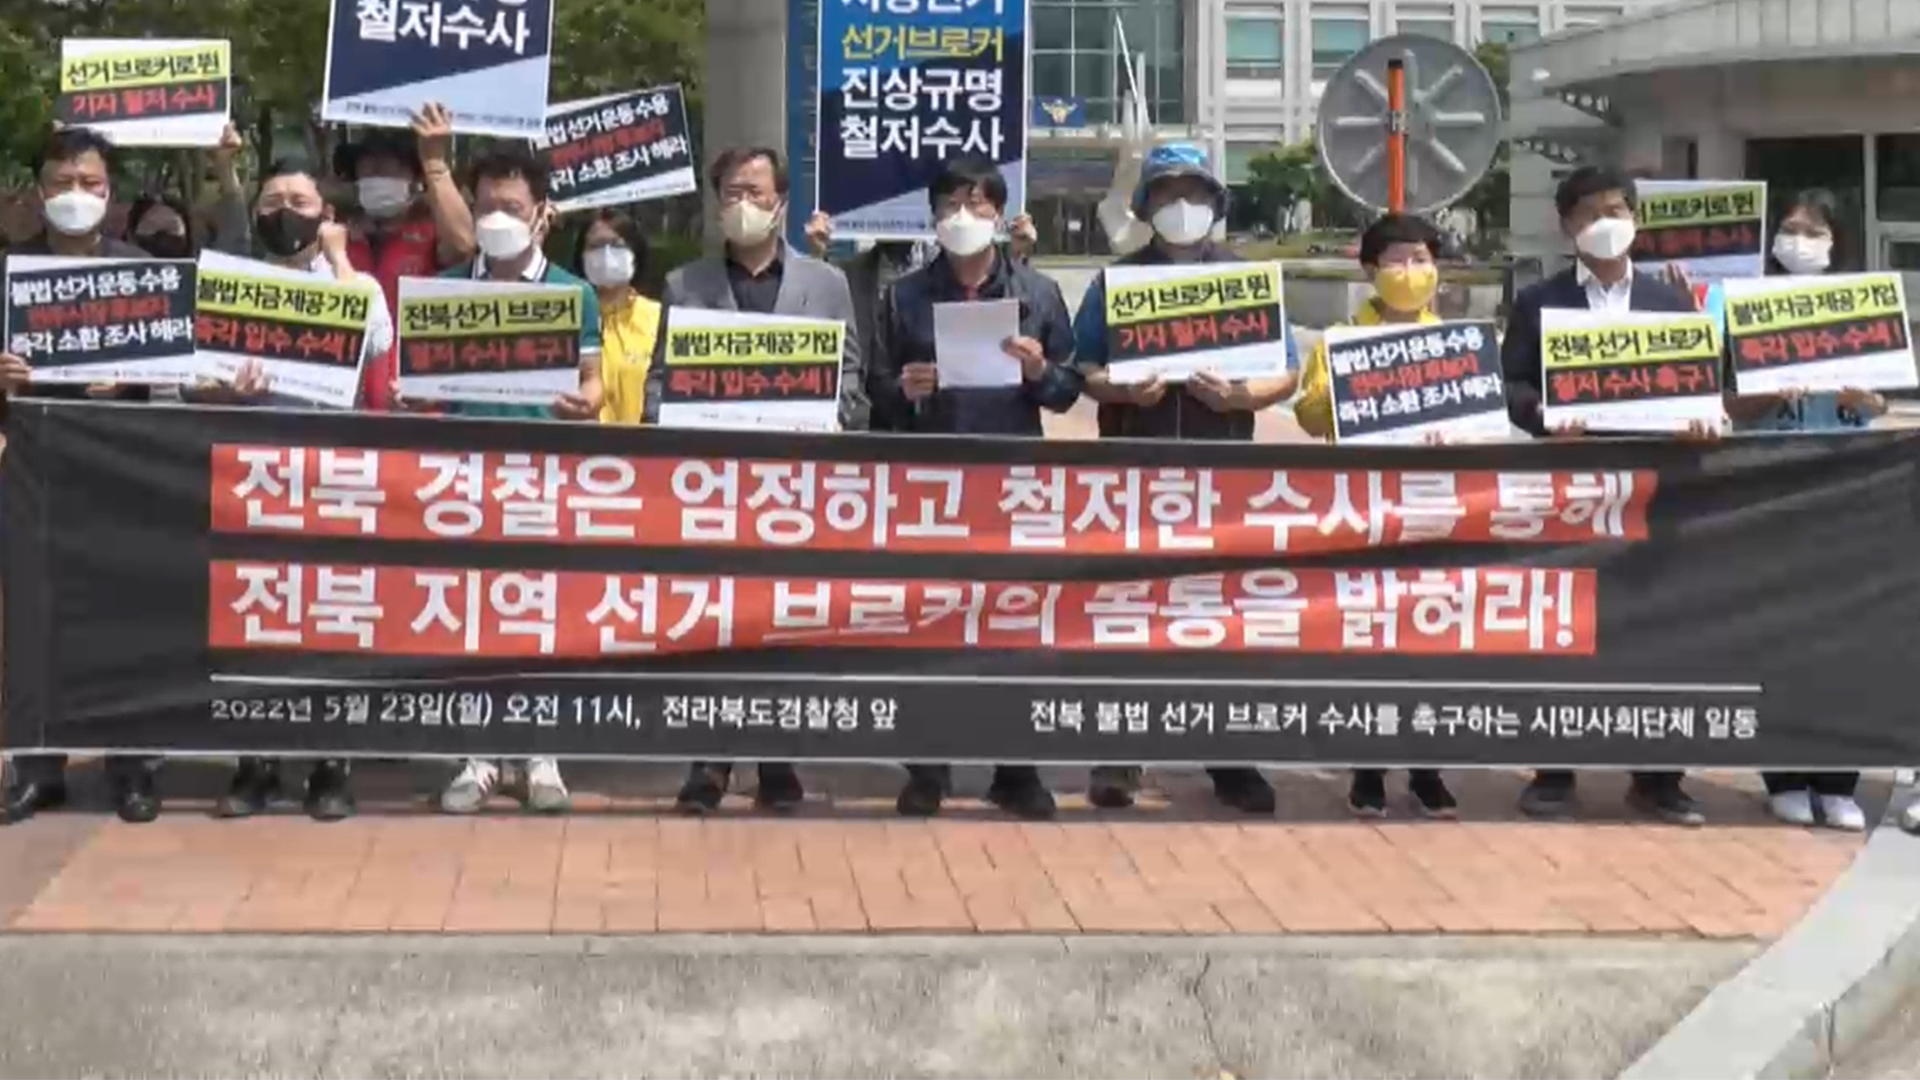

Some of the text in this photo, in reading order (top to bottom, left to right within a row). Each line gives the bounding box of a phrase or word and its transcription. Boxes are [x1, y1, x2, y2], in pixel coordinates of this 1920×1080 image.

[356, 0, 530, 55] 철저수사
[841, 24, 1004, 61] 선거브로커
[840, 67, 1003, 111] 진상규명
[840, 116, 1005, 159] 철저수사
[615, 145, 650, 171] 조사
[241, 282, 281, 311] 자금
[328, 294, 369, 322] 기업
[404, 296, 576, 331] 전북 선거 브로커
[1111, 288, 1157, 319] 선거
[1775, 293, 1815, 319] 자금
[1857, 282, 1899, 308] 기업
[104, 319, 147, 347] 조사
[671, 330, 711, 357] 불법
[713, 331, 752, 356] 자금
[754, 329, 797, 355] 제공
[798, 330, 838, 355] 기업
[1221, 309, 1269, 342] 수사
[1549, 324, 1714, 362] 전북 선거 브로커
[1421, 379, 1462, 408] 조사
[1604, 366, 1651, 401] 수사
[231, 447, 1634, 551] 전북 경찰은 엄정하고 철저한 수사를 통해
[230, 563, 1576, 654] 전북 지역 선거 브로커의 몸통을 밝혀라!
[211, 692, 898, 731] 2022년 5월 23일(월) 오전 11시, 전라북도경찰청 앞
[1030, 700, 1759, 739] 전북 불법 선거 브로커 수사를 촉구하는 시민사회단체 일동
